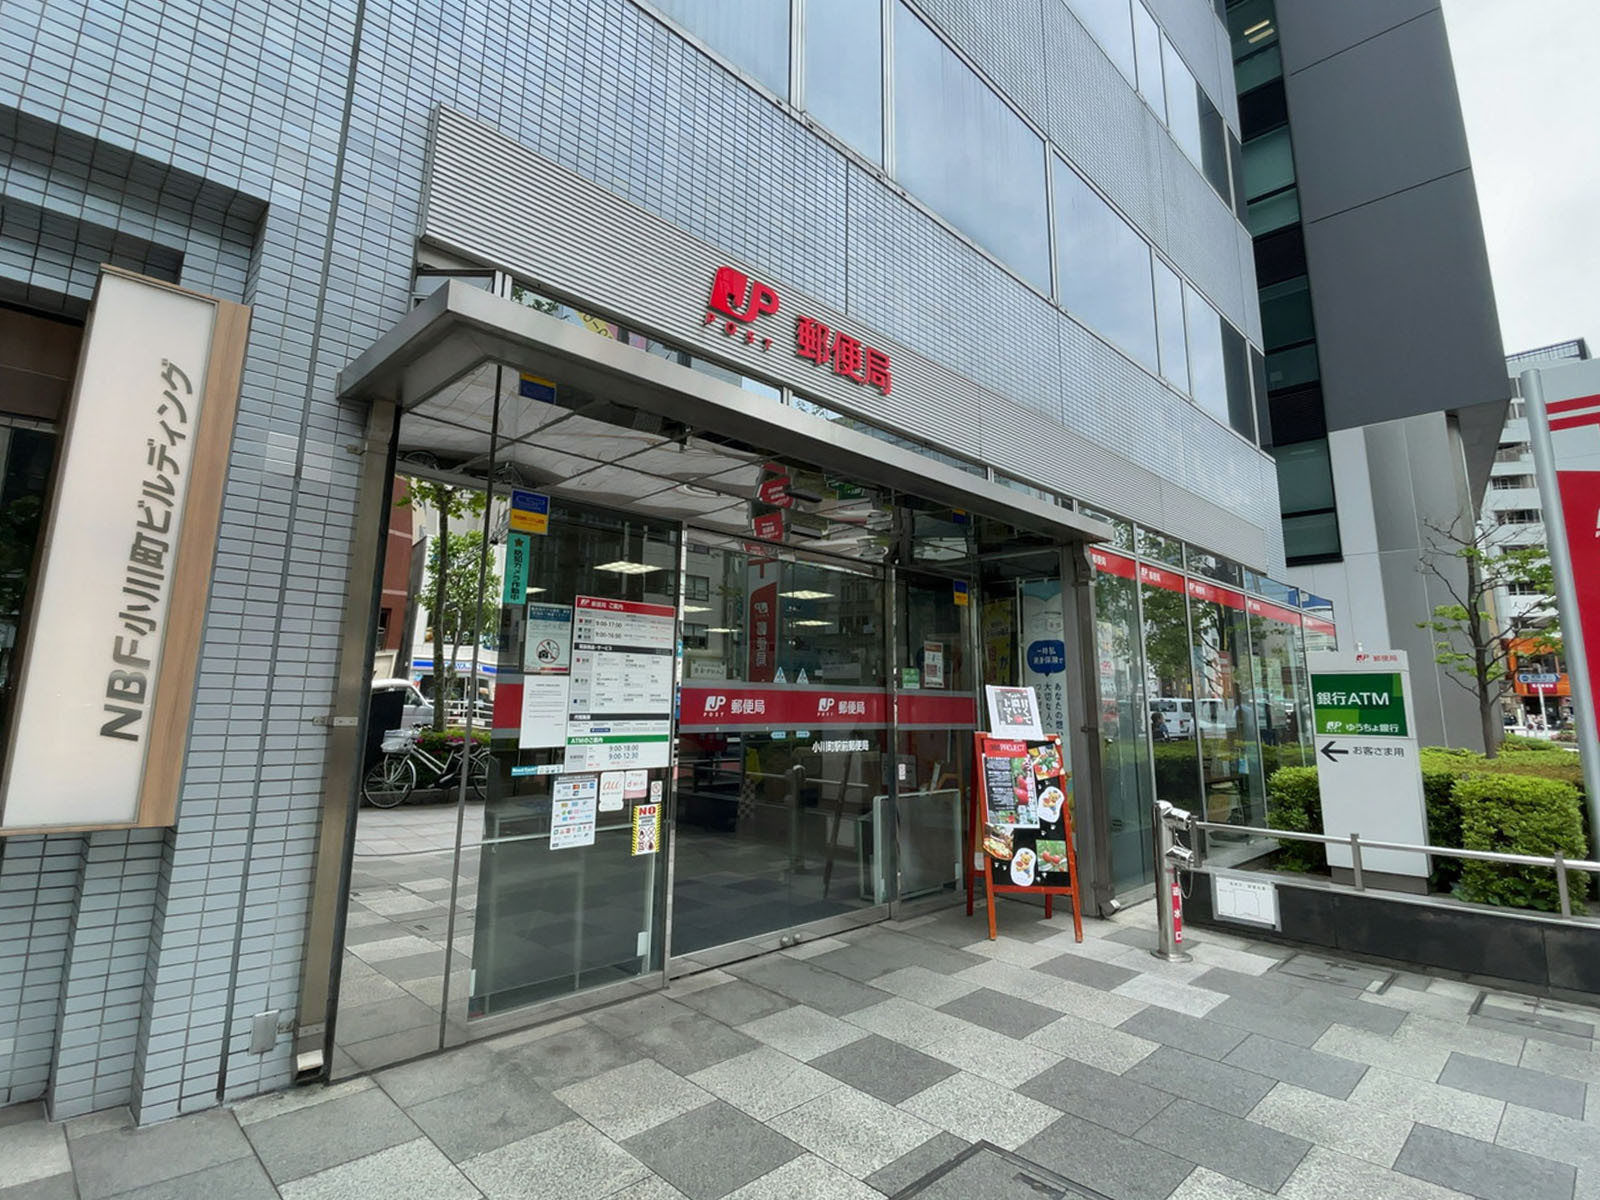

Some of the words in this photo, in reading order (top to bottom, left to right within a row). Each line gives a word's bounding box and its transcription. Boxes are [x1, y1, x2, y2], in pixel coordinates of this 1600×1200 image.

[708, 266, 780, 323] JP
[704, 312, 773, 351] POST
[796, 314, 892, 396] 郵便局
[100, 358, 193, 742] NBF小川町ビルディング
[730, 698, 766, 715] 郵便局
[1044, 682, 1053, 729] 大切な人へ
[1316, 691, 1390, 706] 銀行ATM
[838, 700, 866, 715] 郵便局
[1346, 723, 1399, 733] ゆうちょ銀行
[1352, 746, 1405, 758] お客さま用
[602, 780, 620, 791] au
[638, 805, 656, 816] NO
